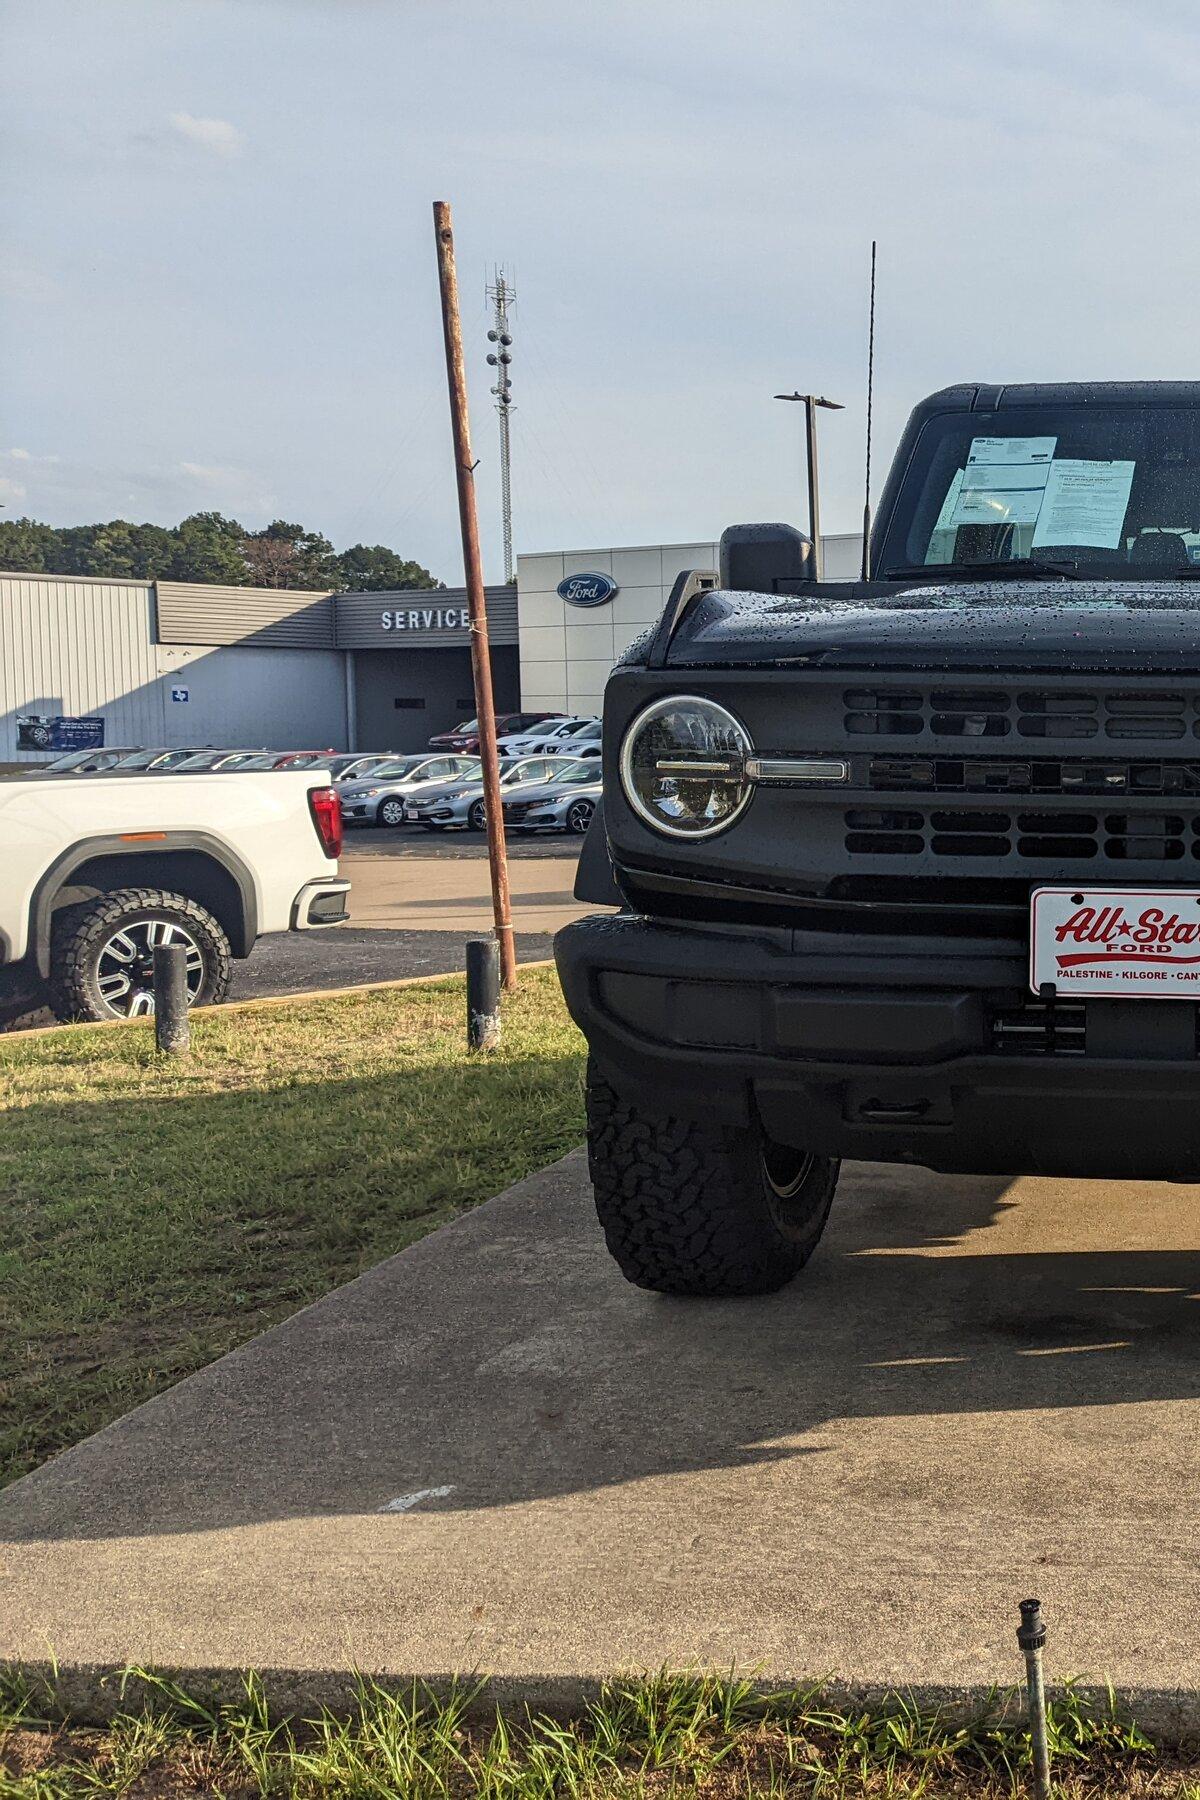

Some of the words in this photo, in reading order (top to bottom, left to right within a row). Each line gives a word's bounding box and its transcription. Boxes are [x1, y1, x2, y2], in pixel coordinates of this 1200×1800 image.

[566, 579, 599, 600] Ford
[381, 608, 470, 630] SERVICE
[1106, 943, 1172, 953] FORD
[1056, 969, 1113, 979] PALESTINE
[1122, 971, 1168, 980] KILGORE
